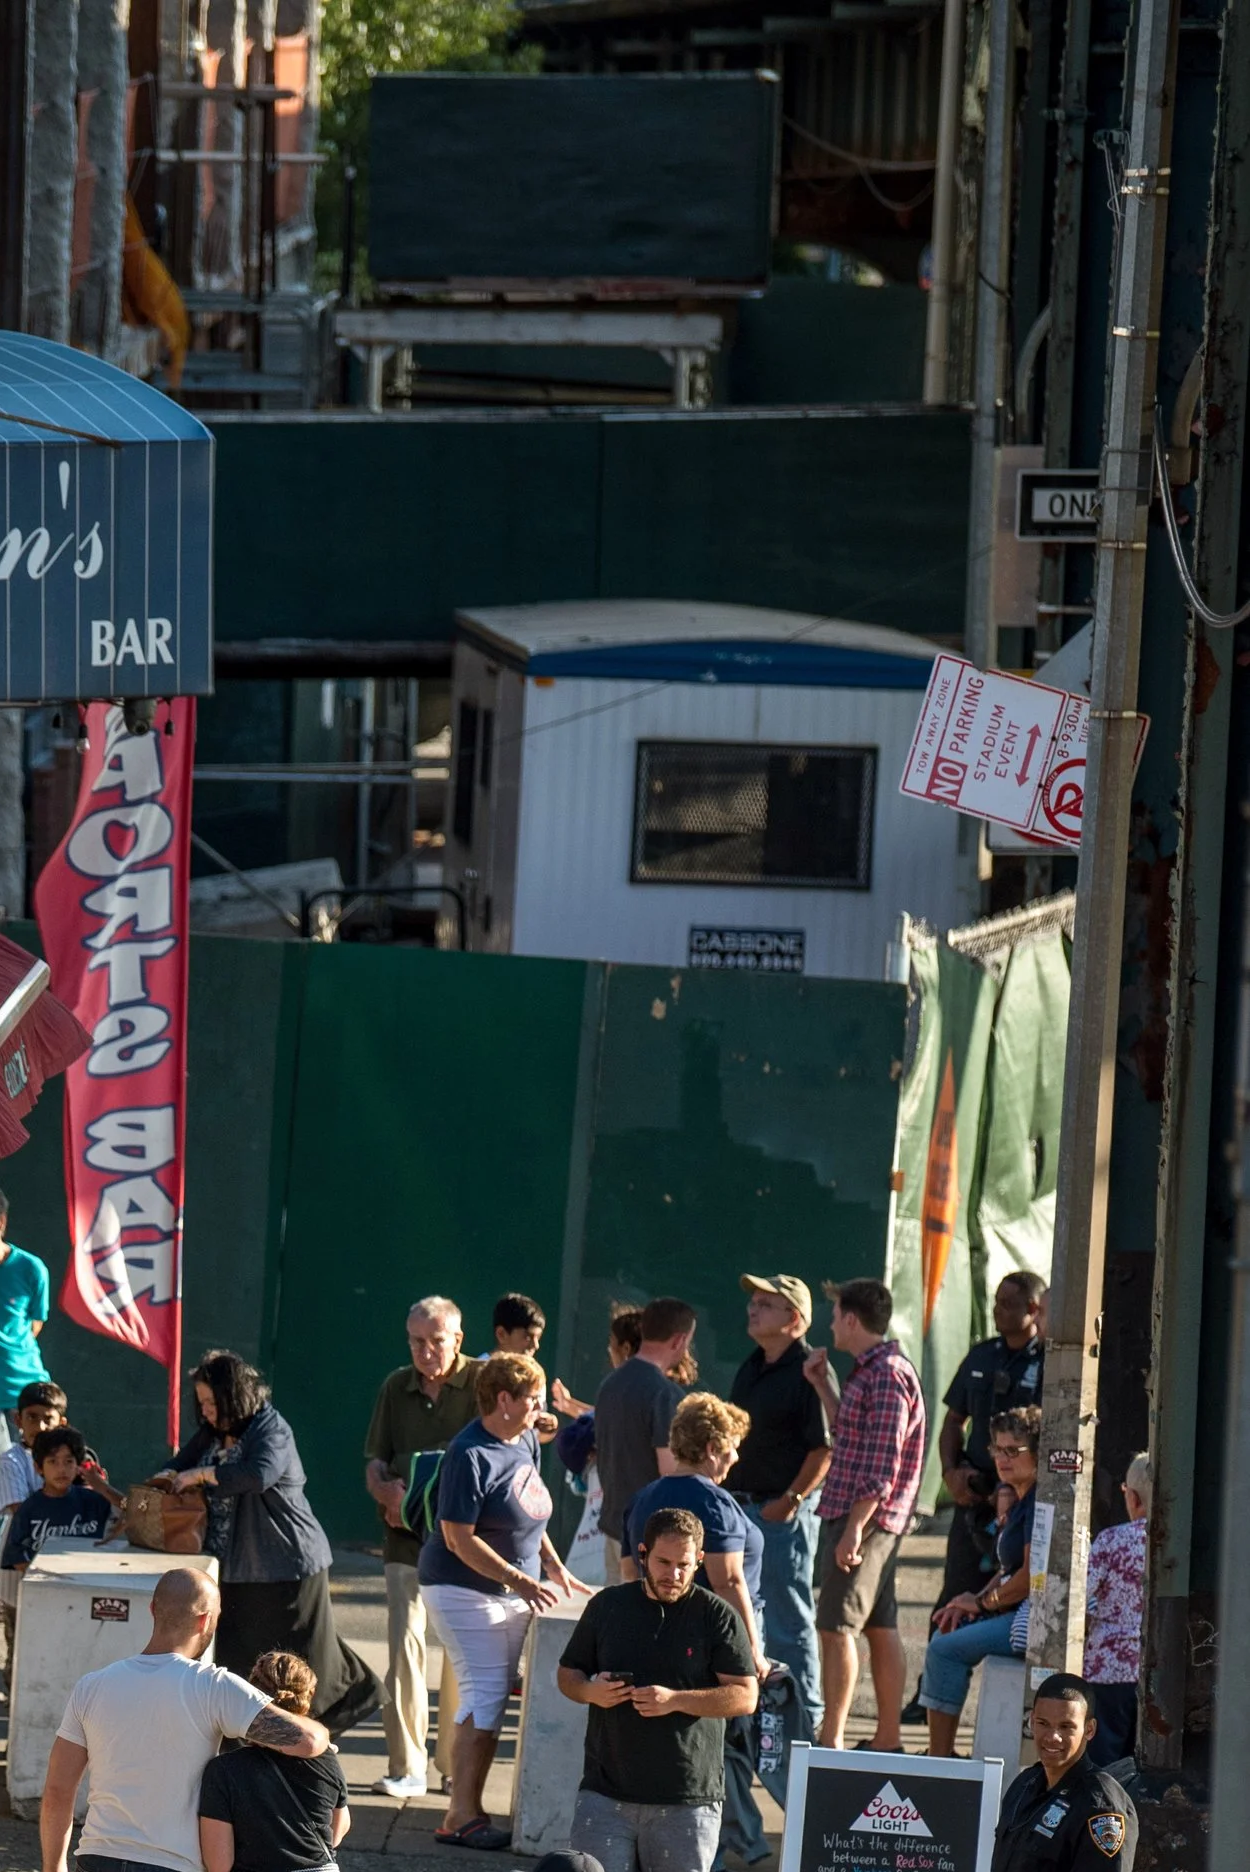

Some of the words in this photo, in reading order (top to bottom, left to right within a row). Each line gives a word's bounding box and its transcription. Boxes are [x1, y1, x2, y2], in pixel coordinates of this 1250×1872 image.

[91, 617, 175, 666] BAR
[916, 751, 928, 775] TOW
[927, 713, 941, 746] AWAY
[935, 678, 952, 709] ZONE
[931, 761, 966, 801] NO
[949, 676, 985, 755] PARKING
[973, 704, 1006, 782] STADIUM
[994, 720, 1021, 779] EVENT
[863, 1796, 922, 1821] Coors
[872, 1819, 910, 1833] LIGHT
[823, 1833, 865, 1850] What's
[869, 1836, 889, 1852] the
[894, 1838, 951, 1855] difference
[833, 1851, 877, 1866] between
[881, 1857, 891, 1867] a
[896, 1854, 916, 1869] Red
[918, 1854, 935, 1870] Sox
[937, 1857, 956, 1872] fan
